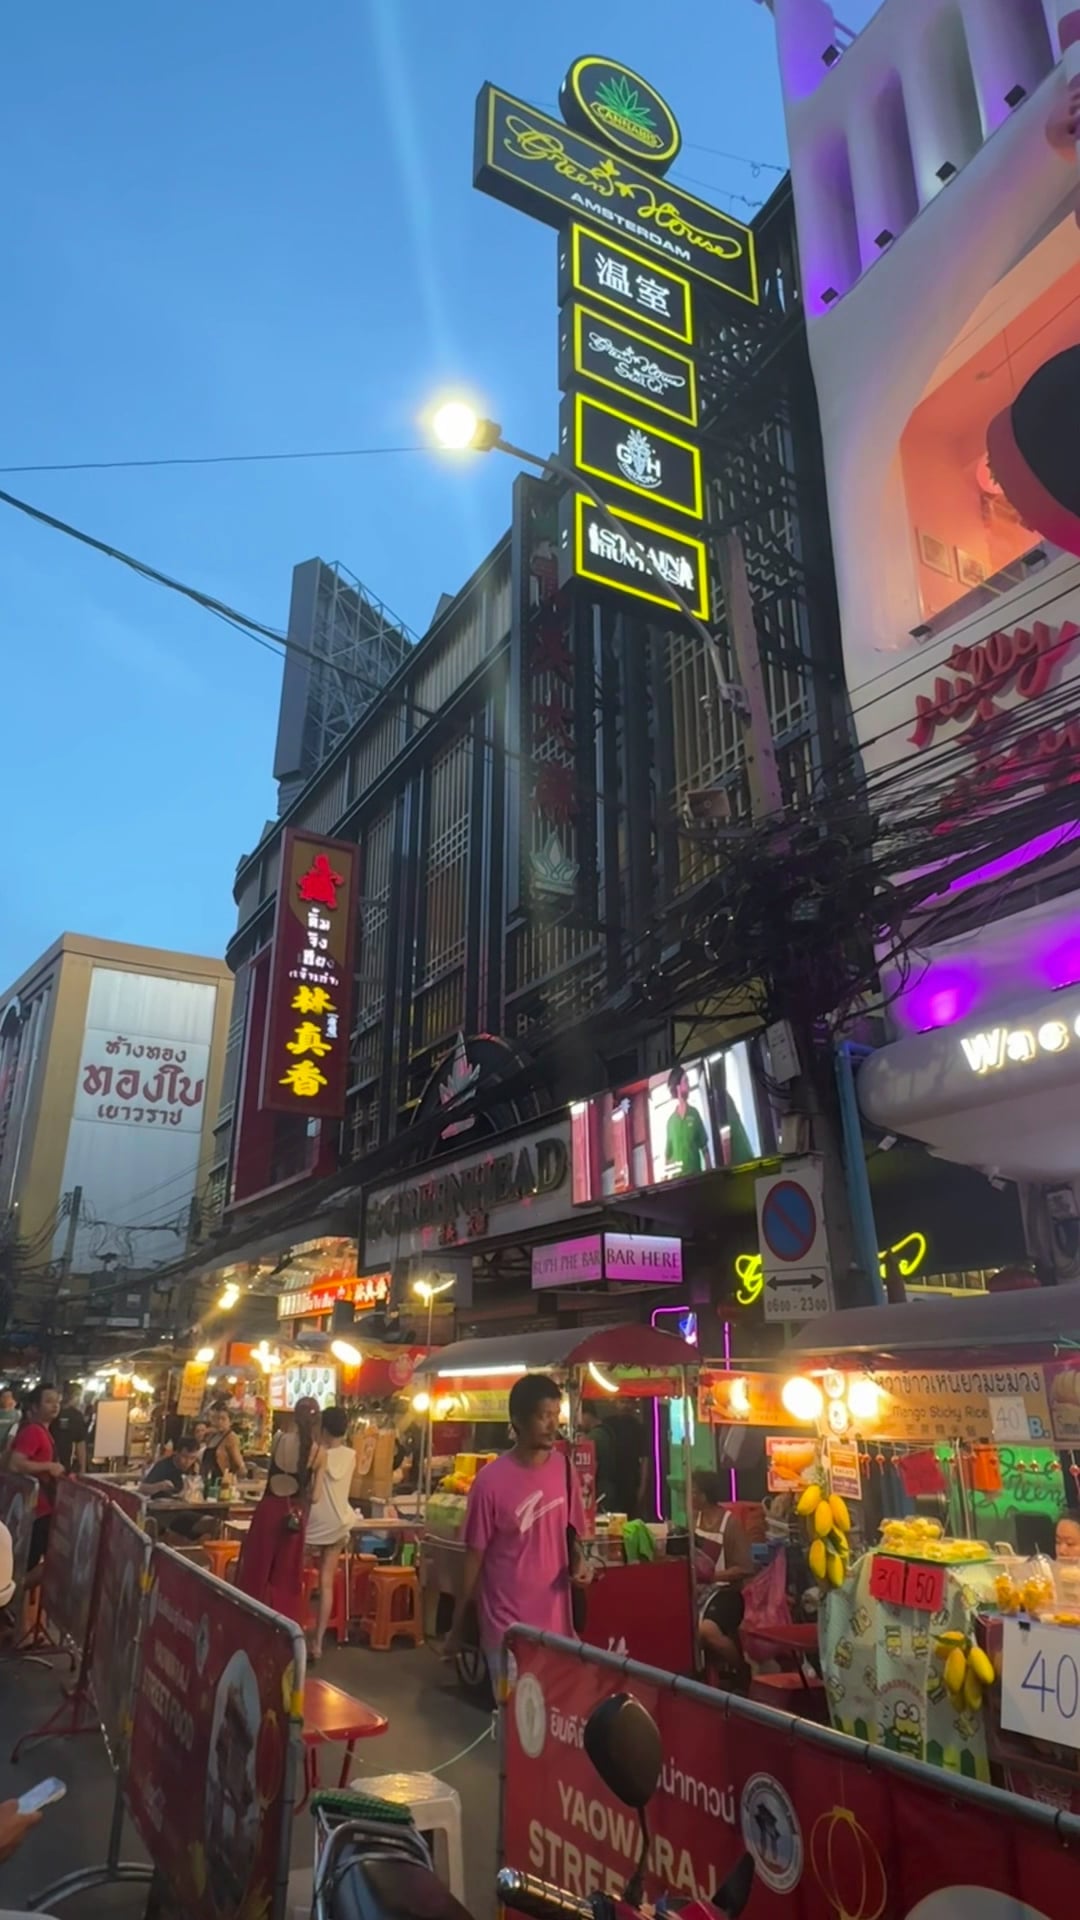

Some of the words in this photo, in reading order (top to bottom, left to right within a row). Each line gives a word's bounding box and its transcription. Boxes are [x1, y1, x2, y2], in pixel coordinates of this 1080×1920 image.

[504, 115, 616, 196] Green
[570, 192, 691, 261] AMSTERDAM
[595, 252, 671, 318] 温室
[105, 1035, 187, 1063] ห้างทอง
[278, 985, 338, 1097] 林真香
[97, 1103, 183, 1126] เยาวราช
[607, 1247, 635, 1265] BAR
[641, 1250, 680, 1268] HERE
[916, 1572, 936, 1604] 50
[1021, 1648, 1079, 1719] 40
[528, 1818, 628, 1902] STREE
